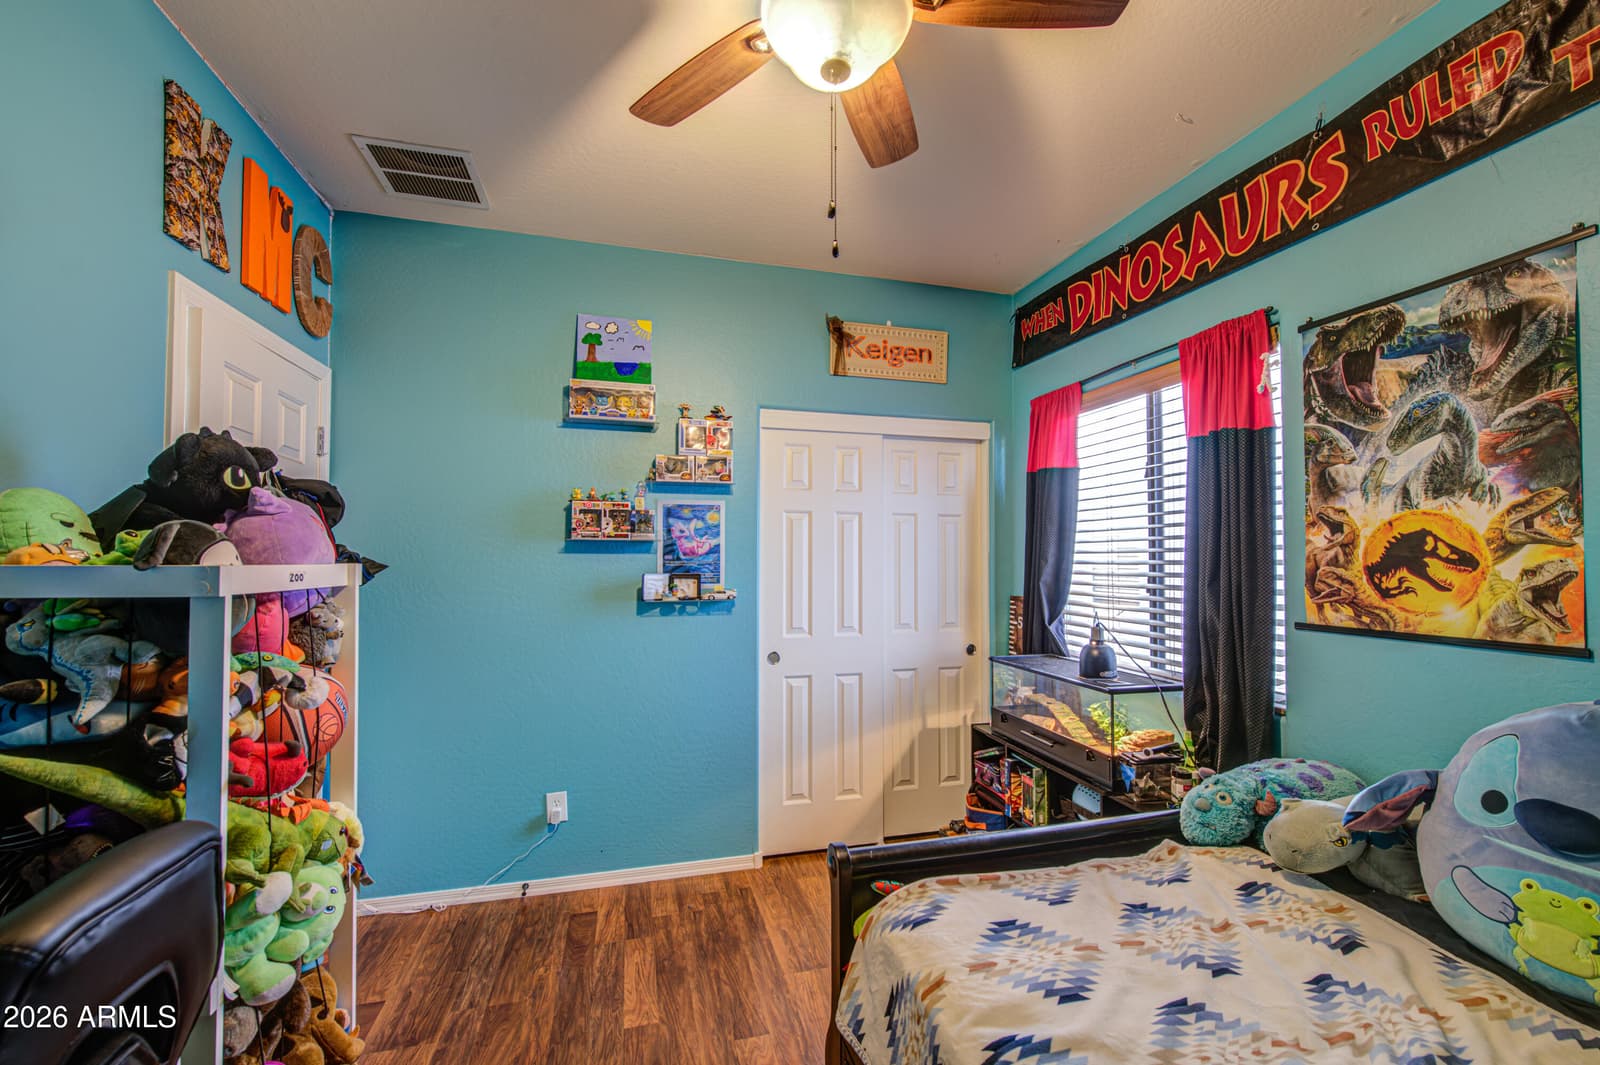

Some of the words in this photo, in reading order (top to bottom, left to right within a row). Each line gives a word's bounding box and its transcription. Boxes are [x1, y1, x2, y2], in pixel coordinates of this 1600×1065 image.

[1021, 297, 1065, 341] WHEN
[1068, 129, 1348, 334] DINOSAURS
[1361, 30, 1525, 161] RULED
[845, 335, 932, 368] Keigen
[289, 573, 304, 582] ZOO
